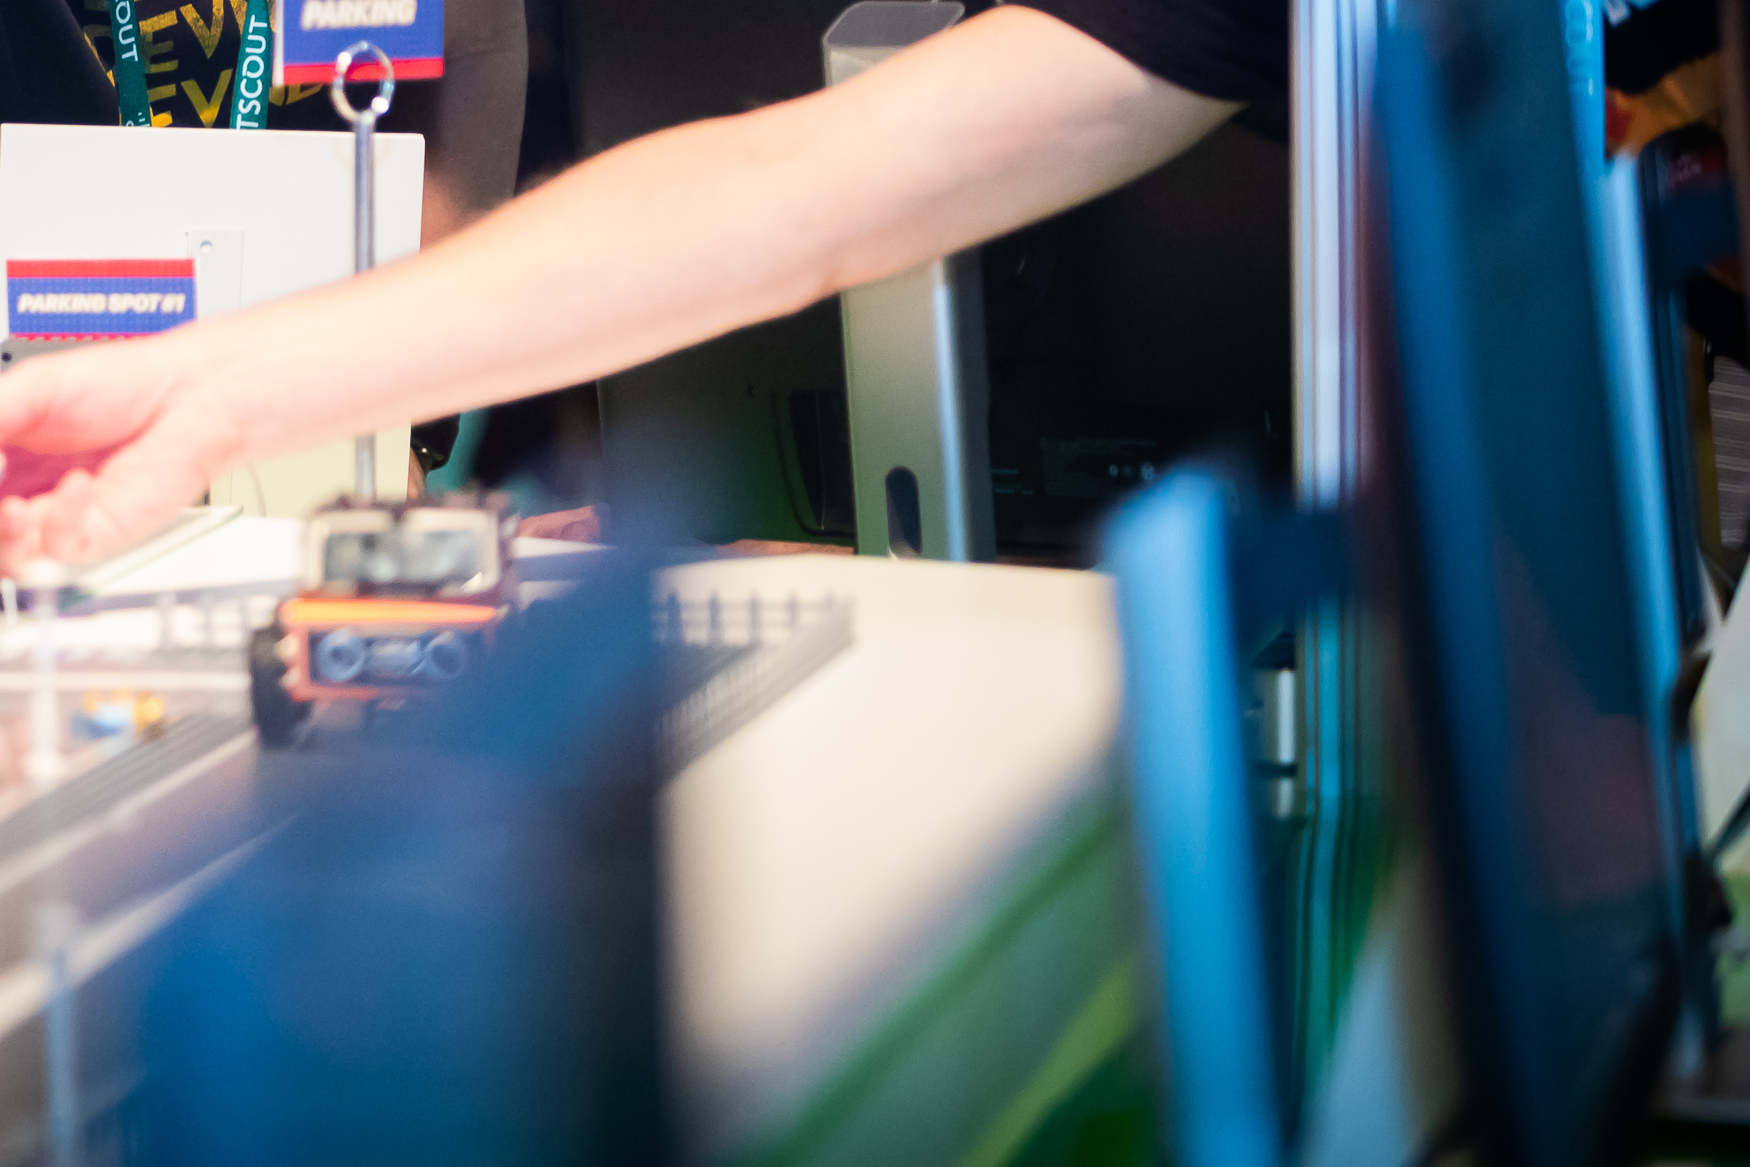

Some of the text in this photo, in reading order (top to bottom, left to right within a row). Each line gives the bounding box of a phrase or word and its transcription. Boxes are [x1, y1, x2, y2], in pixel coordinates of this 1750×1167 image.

[18, 293, 186, 313] PARKING SPOT #1
